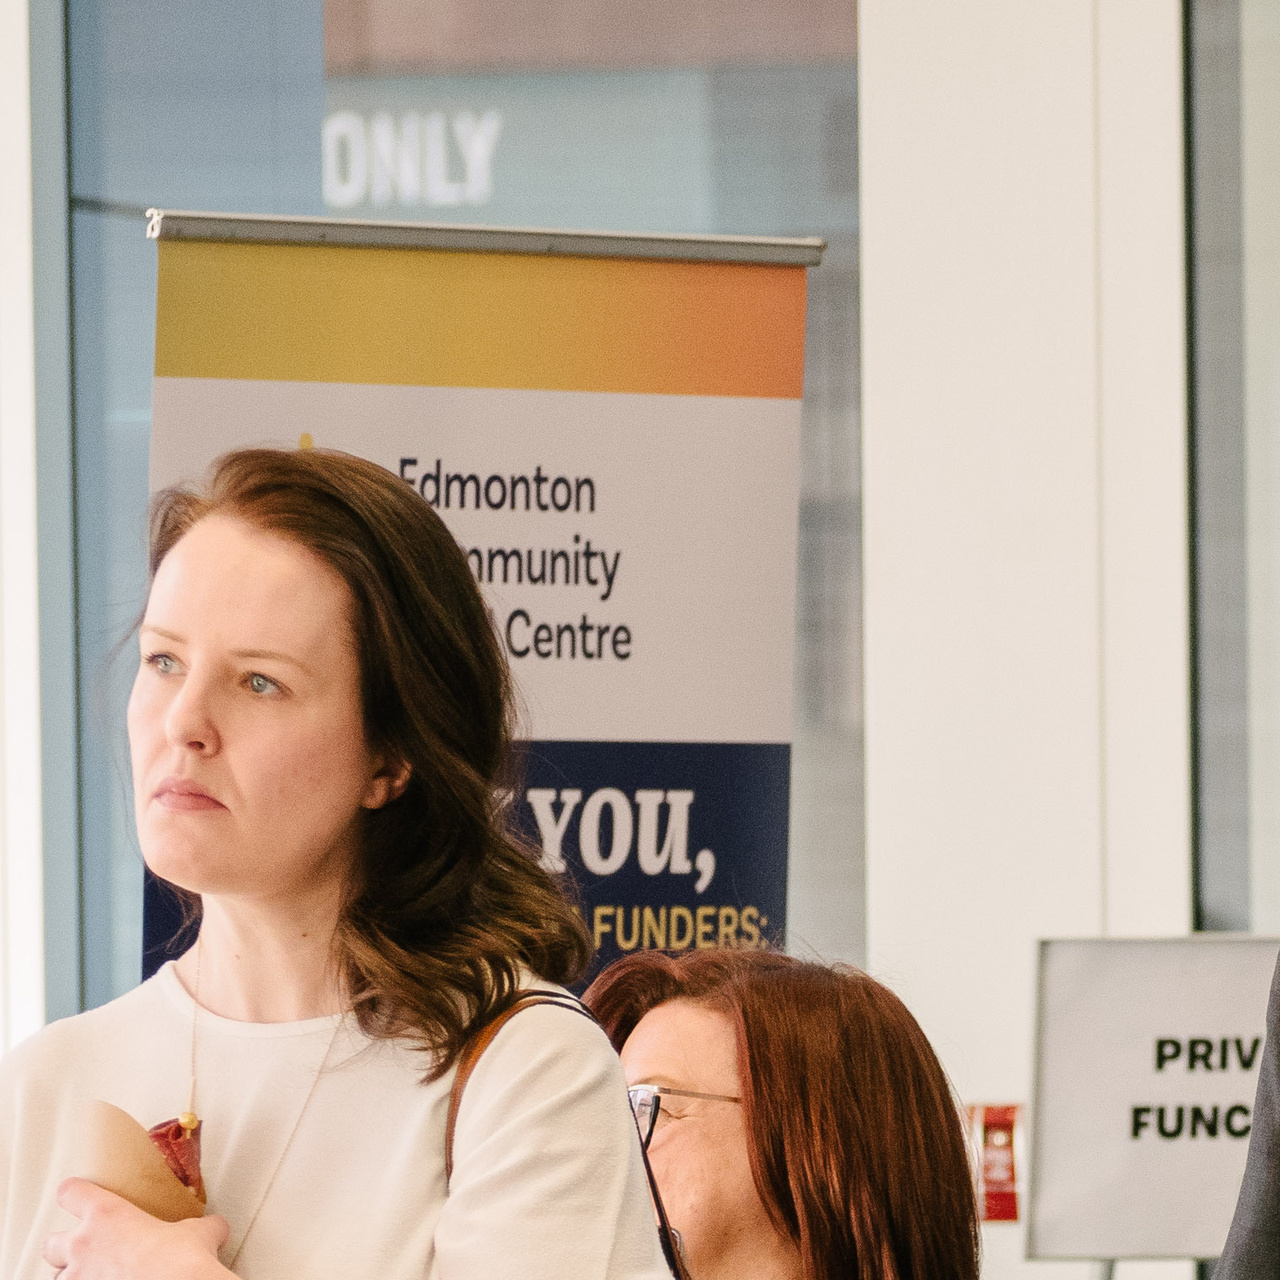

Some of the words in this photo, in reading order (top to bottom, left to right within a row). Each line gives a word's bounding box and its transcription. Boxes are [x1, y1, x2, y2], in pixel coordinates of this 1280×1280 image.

[321, 110, 502, 208] ONLY
[400, 457, 596, 513] Edmonton
[505, 608, 632, 661] Centre
[593, 904, 769, 951] FUNDERS:
[1156, 1037, 1261, 1071] PRIV
[1131, 1104, 1251, 1138] FUNC
